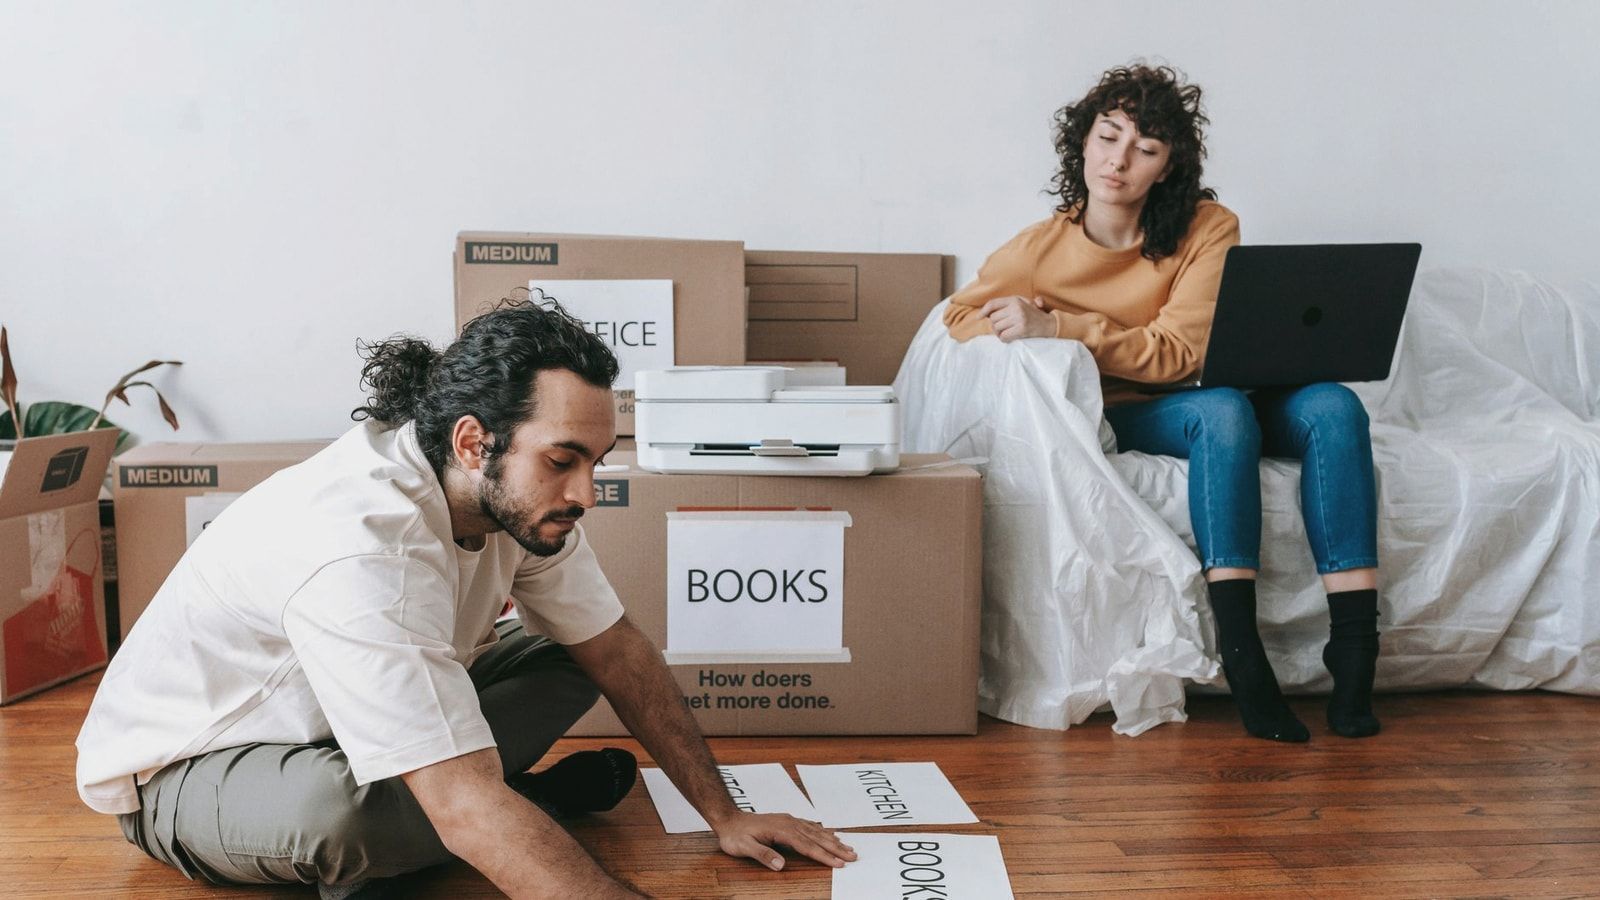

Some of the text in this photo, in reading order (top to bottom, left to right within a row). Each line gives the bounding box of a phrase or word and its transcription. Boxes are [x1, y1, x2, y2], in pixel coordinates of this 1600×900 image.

[472, 245, 551, 261] MEDIUM
[583, 321, 657, 347] FICE
[127, 468, 210, 484] MEDIUM
[687, 569, 828, 603] BOOKS
[699, 670, 812, 687] How doers
[717, 695, 770, 709] more
[855, 770, 913, 819] KITCHEN
[898, 841, 948, 900] BOOK
